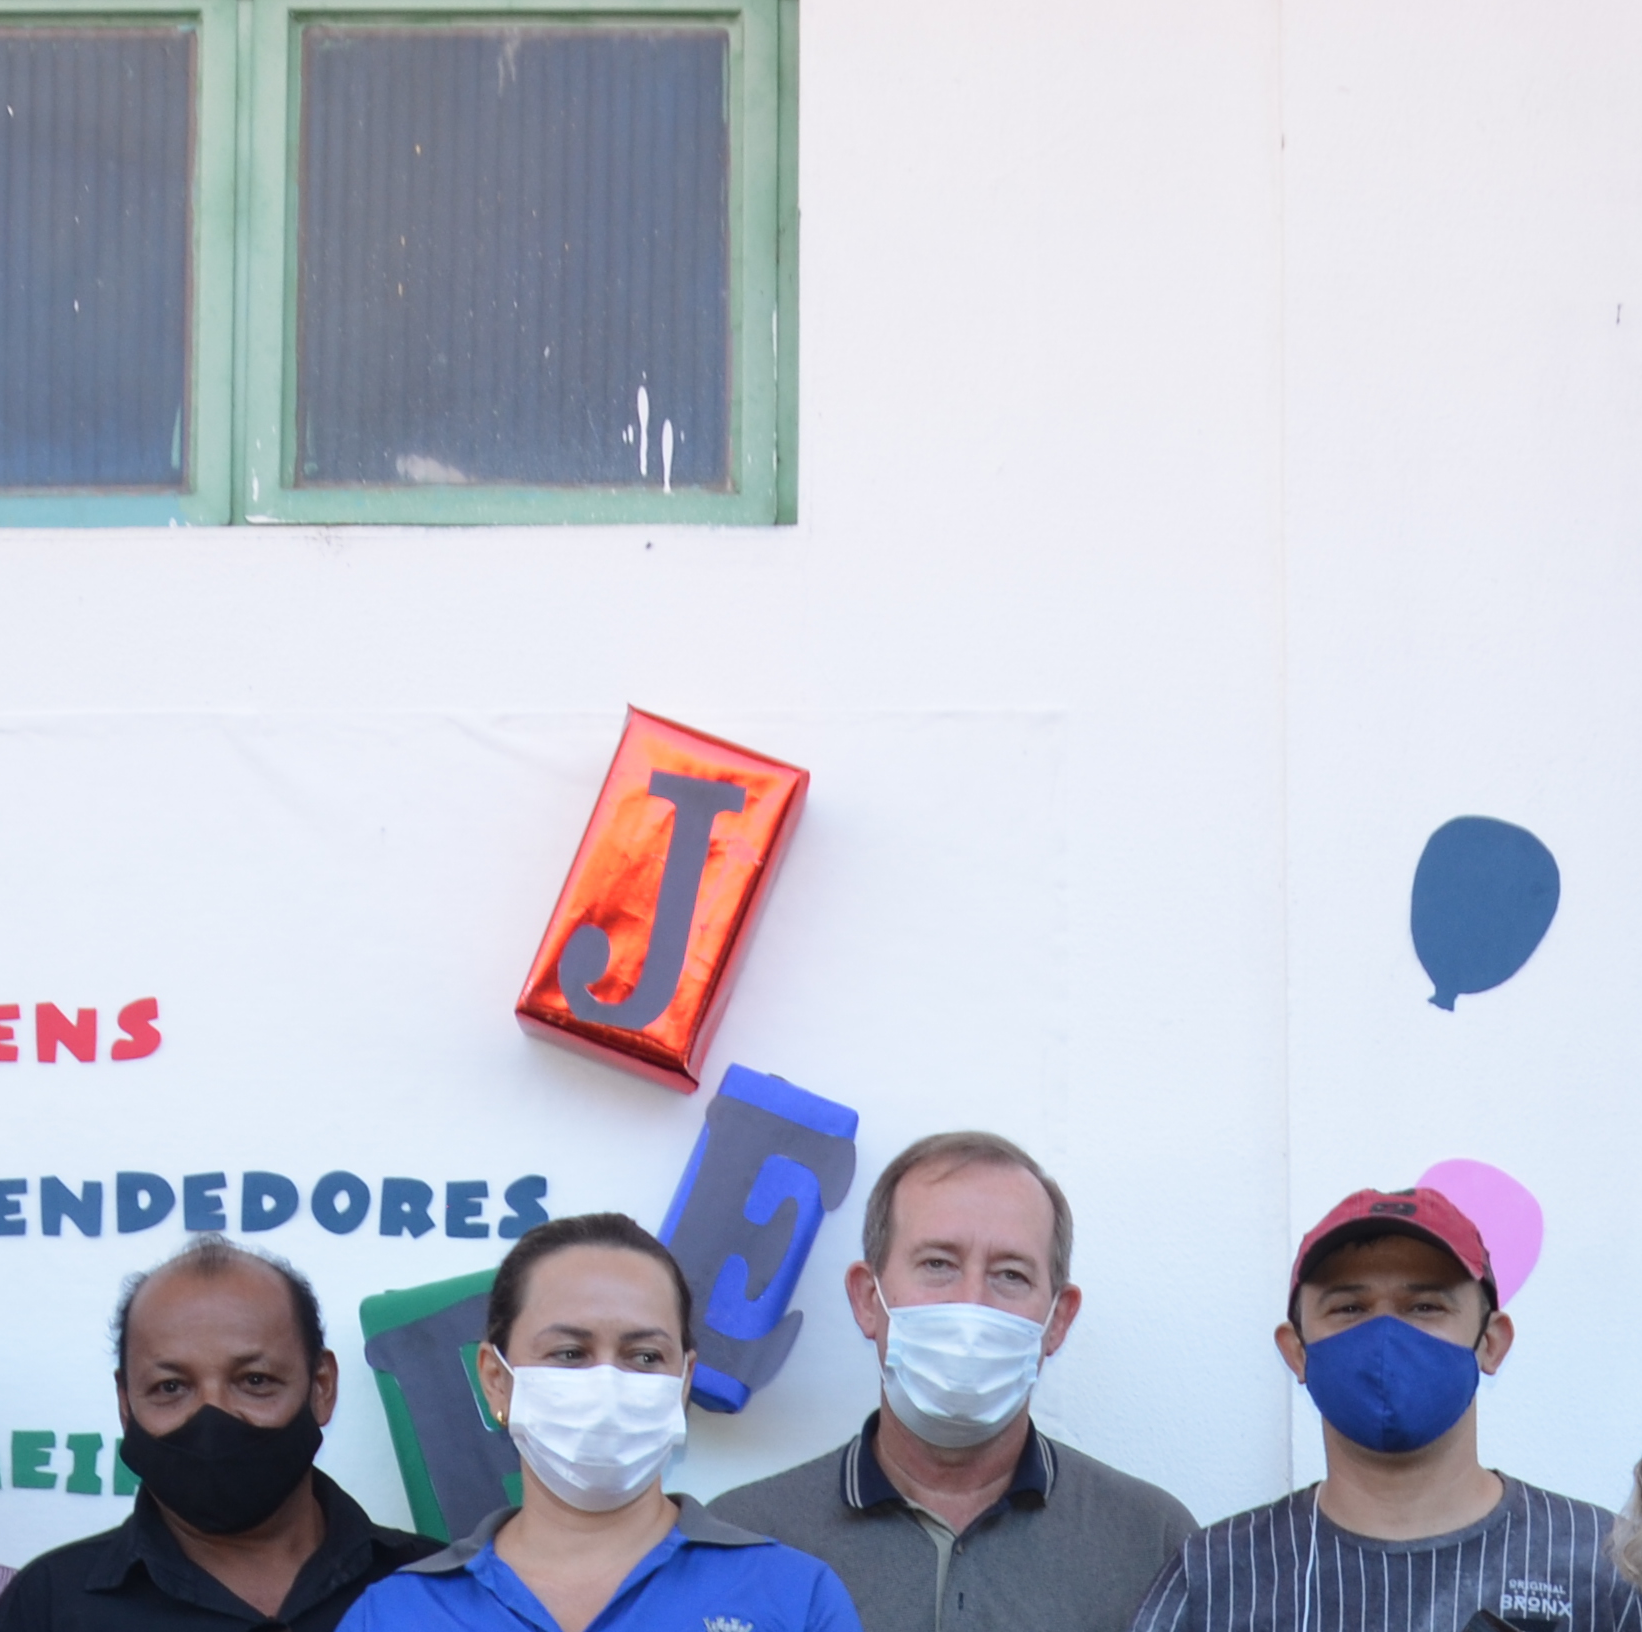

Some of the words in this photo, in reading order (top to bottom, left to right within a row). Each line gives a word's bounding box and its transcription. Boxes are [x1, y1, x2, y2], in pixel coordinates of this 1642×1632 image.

[558, 769, 746, 1029] J
[1508, 1578, 1567, 1595] ORIGINAL
[1500, 1593, 1573, 1619] BRONX
